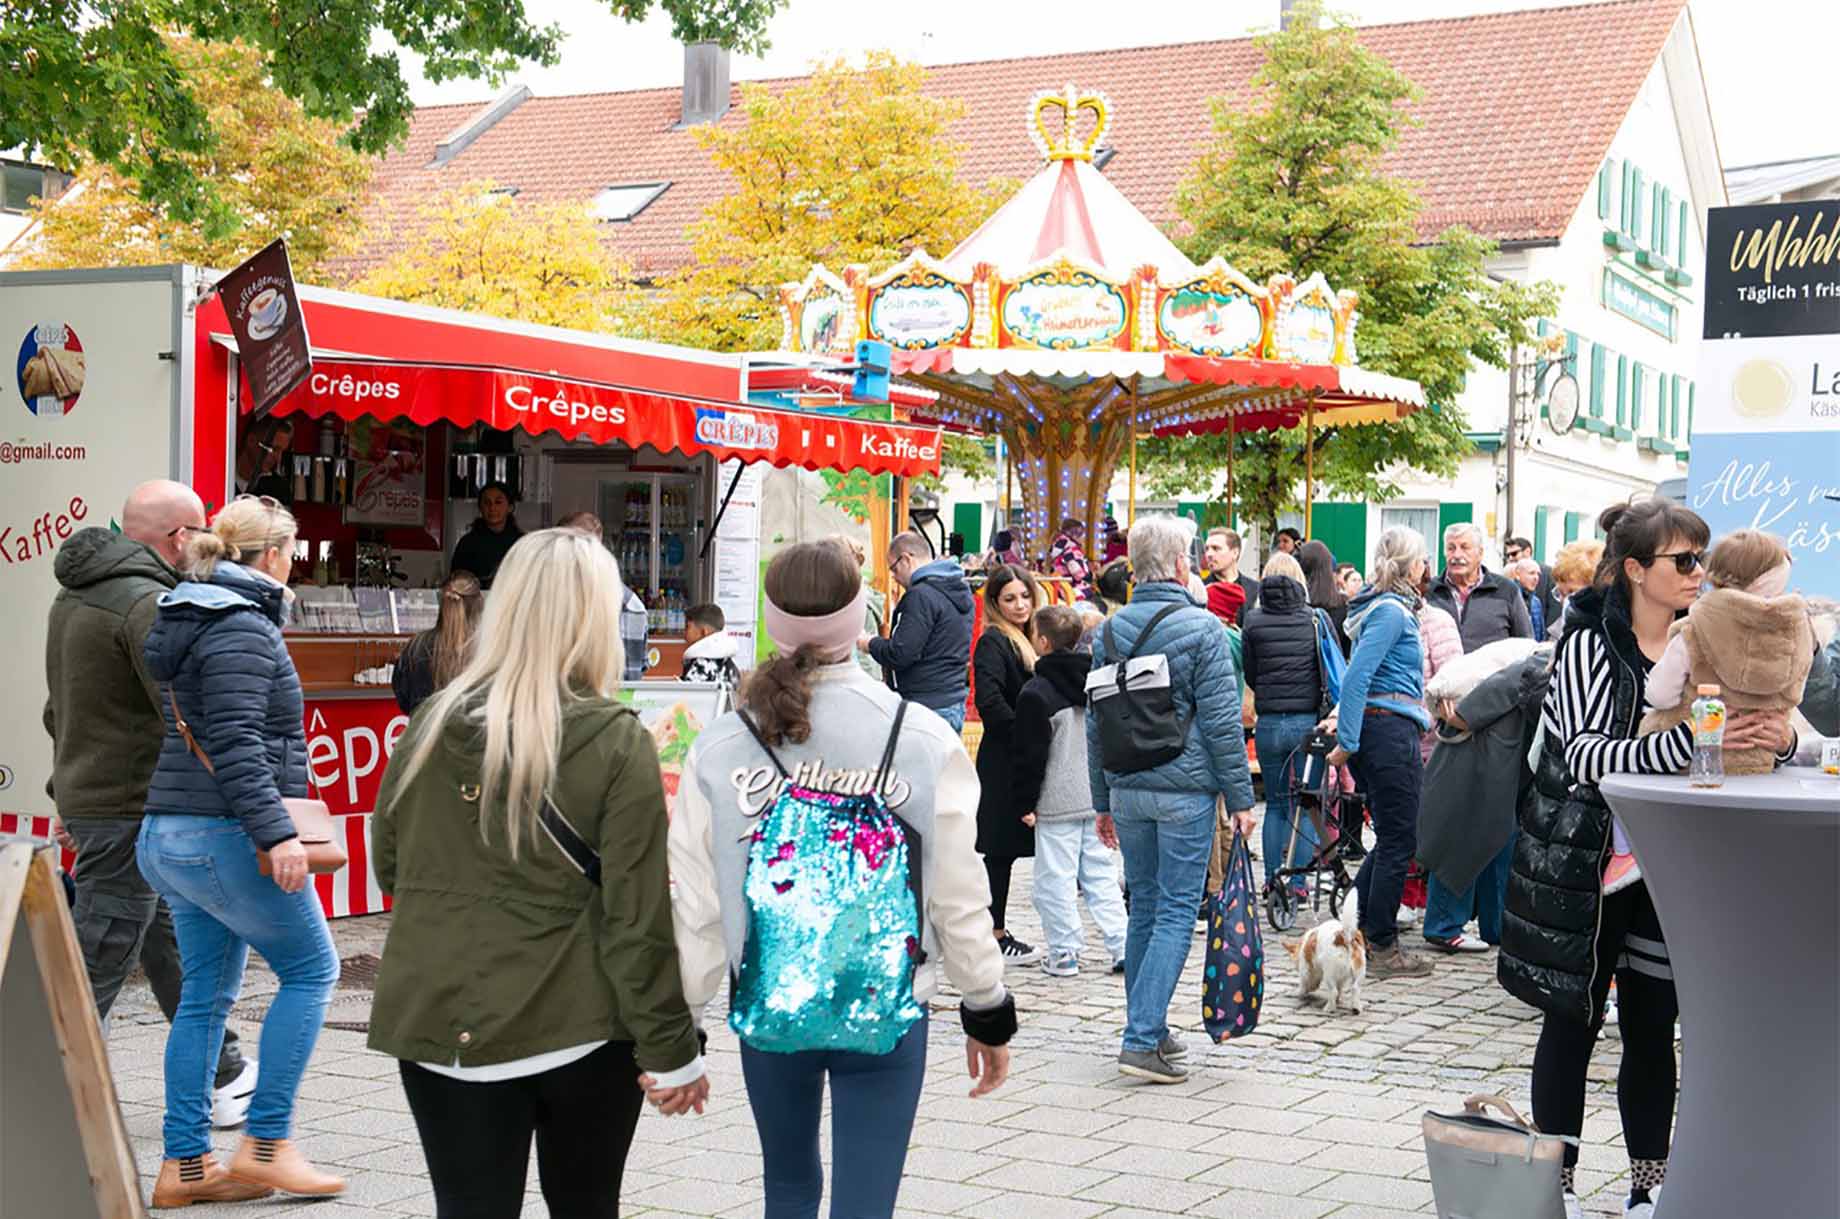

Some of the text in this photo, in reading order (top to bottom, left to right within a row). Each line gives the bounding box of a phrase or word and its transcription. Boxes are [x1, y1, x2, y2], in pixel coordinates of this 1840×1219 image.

[1738, 285, 1796, 304] Täglich
[1802, 284, 1809, 298] 1
[311, 374, 401, 401] Crêpes
[505, 386, 626, 425] Crêpes
[1810, 400, 1840, 417] Käs
[860, 433, 936, 460] Kaffee
[1693, 460, 1797, 508] Alles
[0, 496, 88, 563] Kaffee
